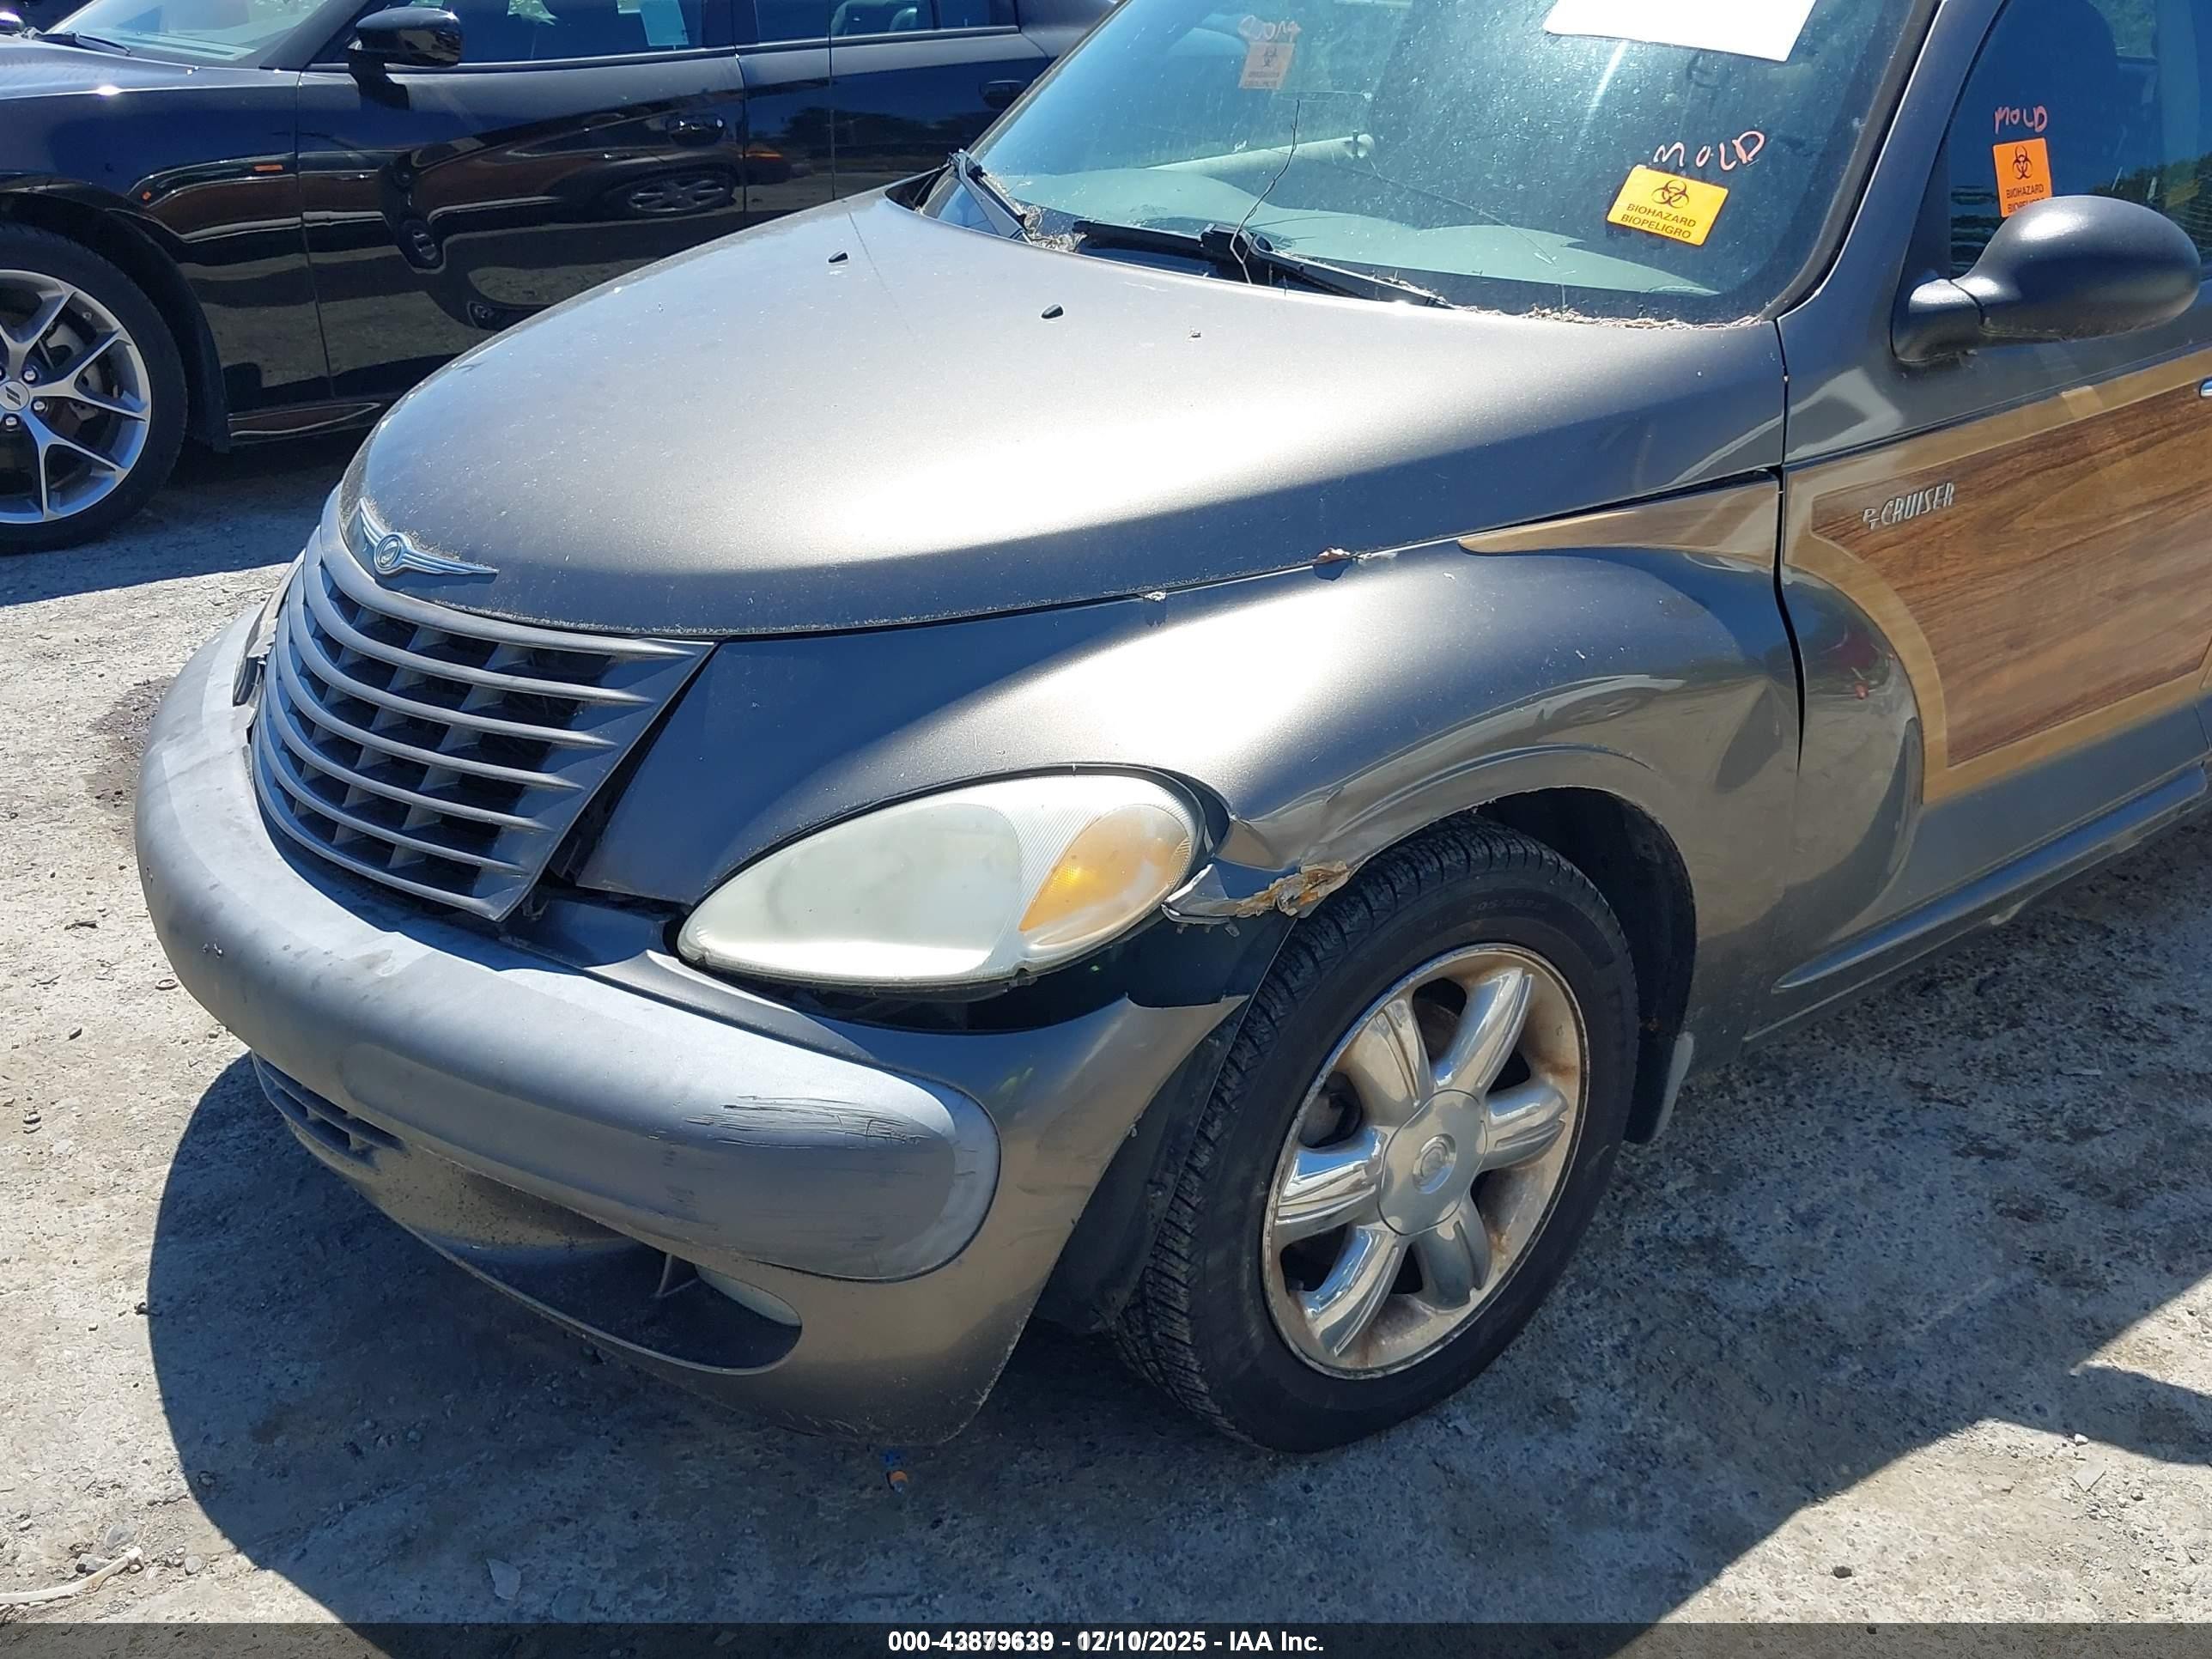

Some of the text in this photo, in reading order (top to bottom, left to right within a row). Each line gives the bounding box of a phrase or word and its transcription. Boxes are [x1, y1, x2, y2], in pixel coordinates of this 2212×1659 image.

[1994, 105, 2048, 135] MOLD
[1652, 131, 1765, 171] MOLD
[2005, 183, 2045, 199] BIOHAZARD
[1620, 213, 1692, 240] BIOPELIGRO
[1626, 203, 1697, 228] BIOHAZARD
[1881, 482, 1955, 526] CRUISER
